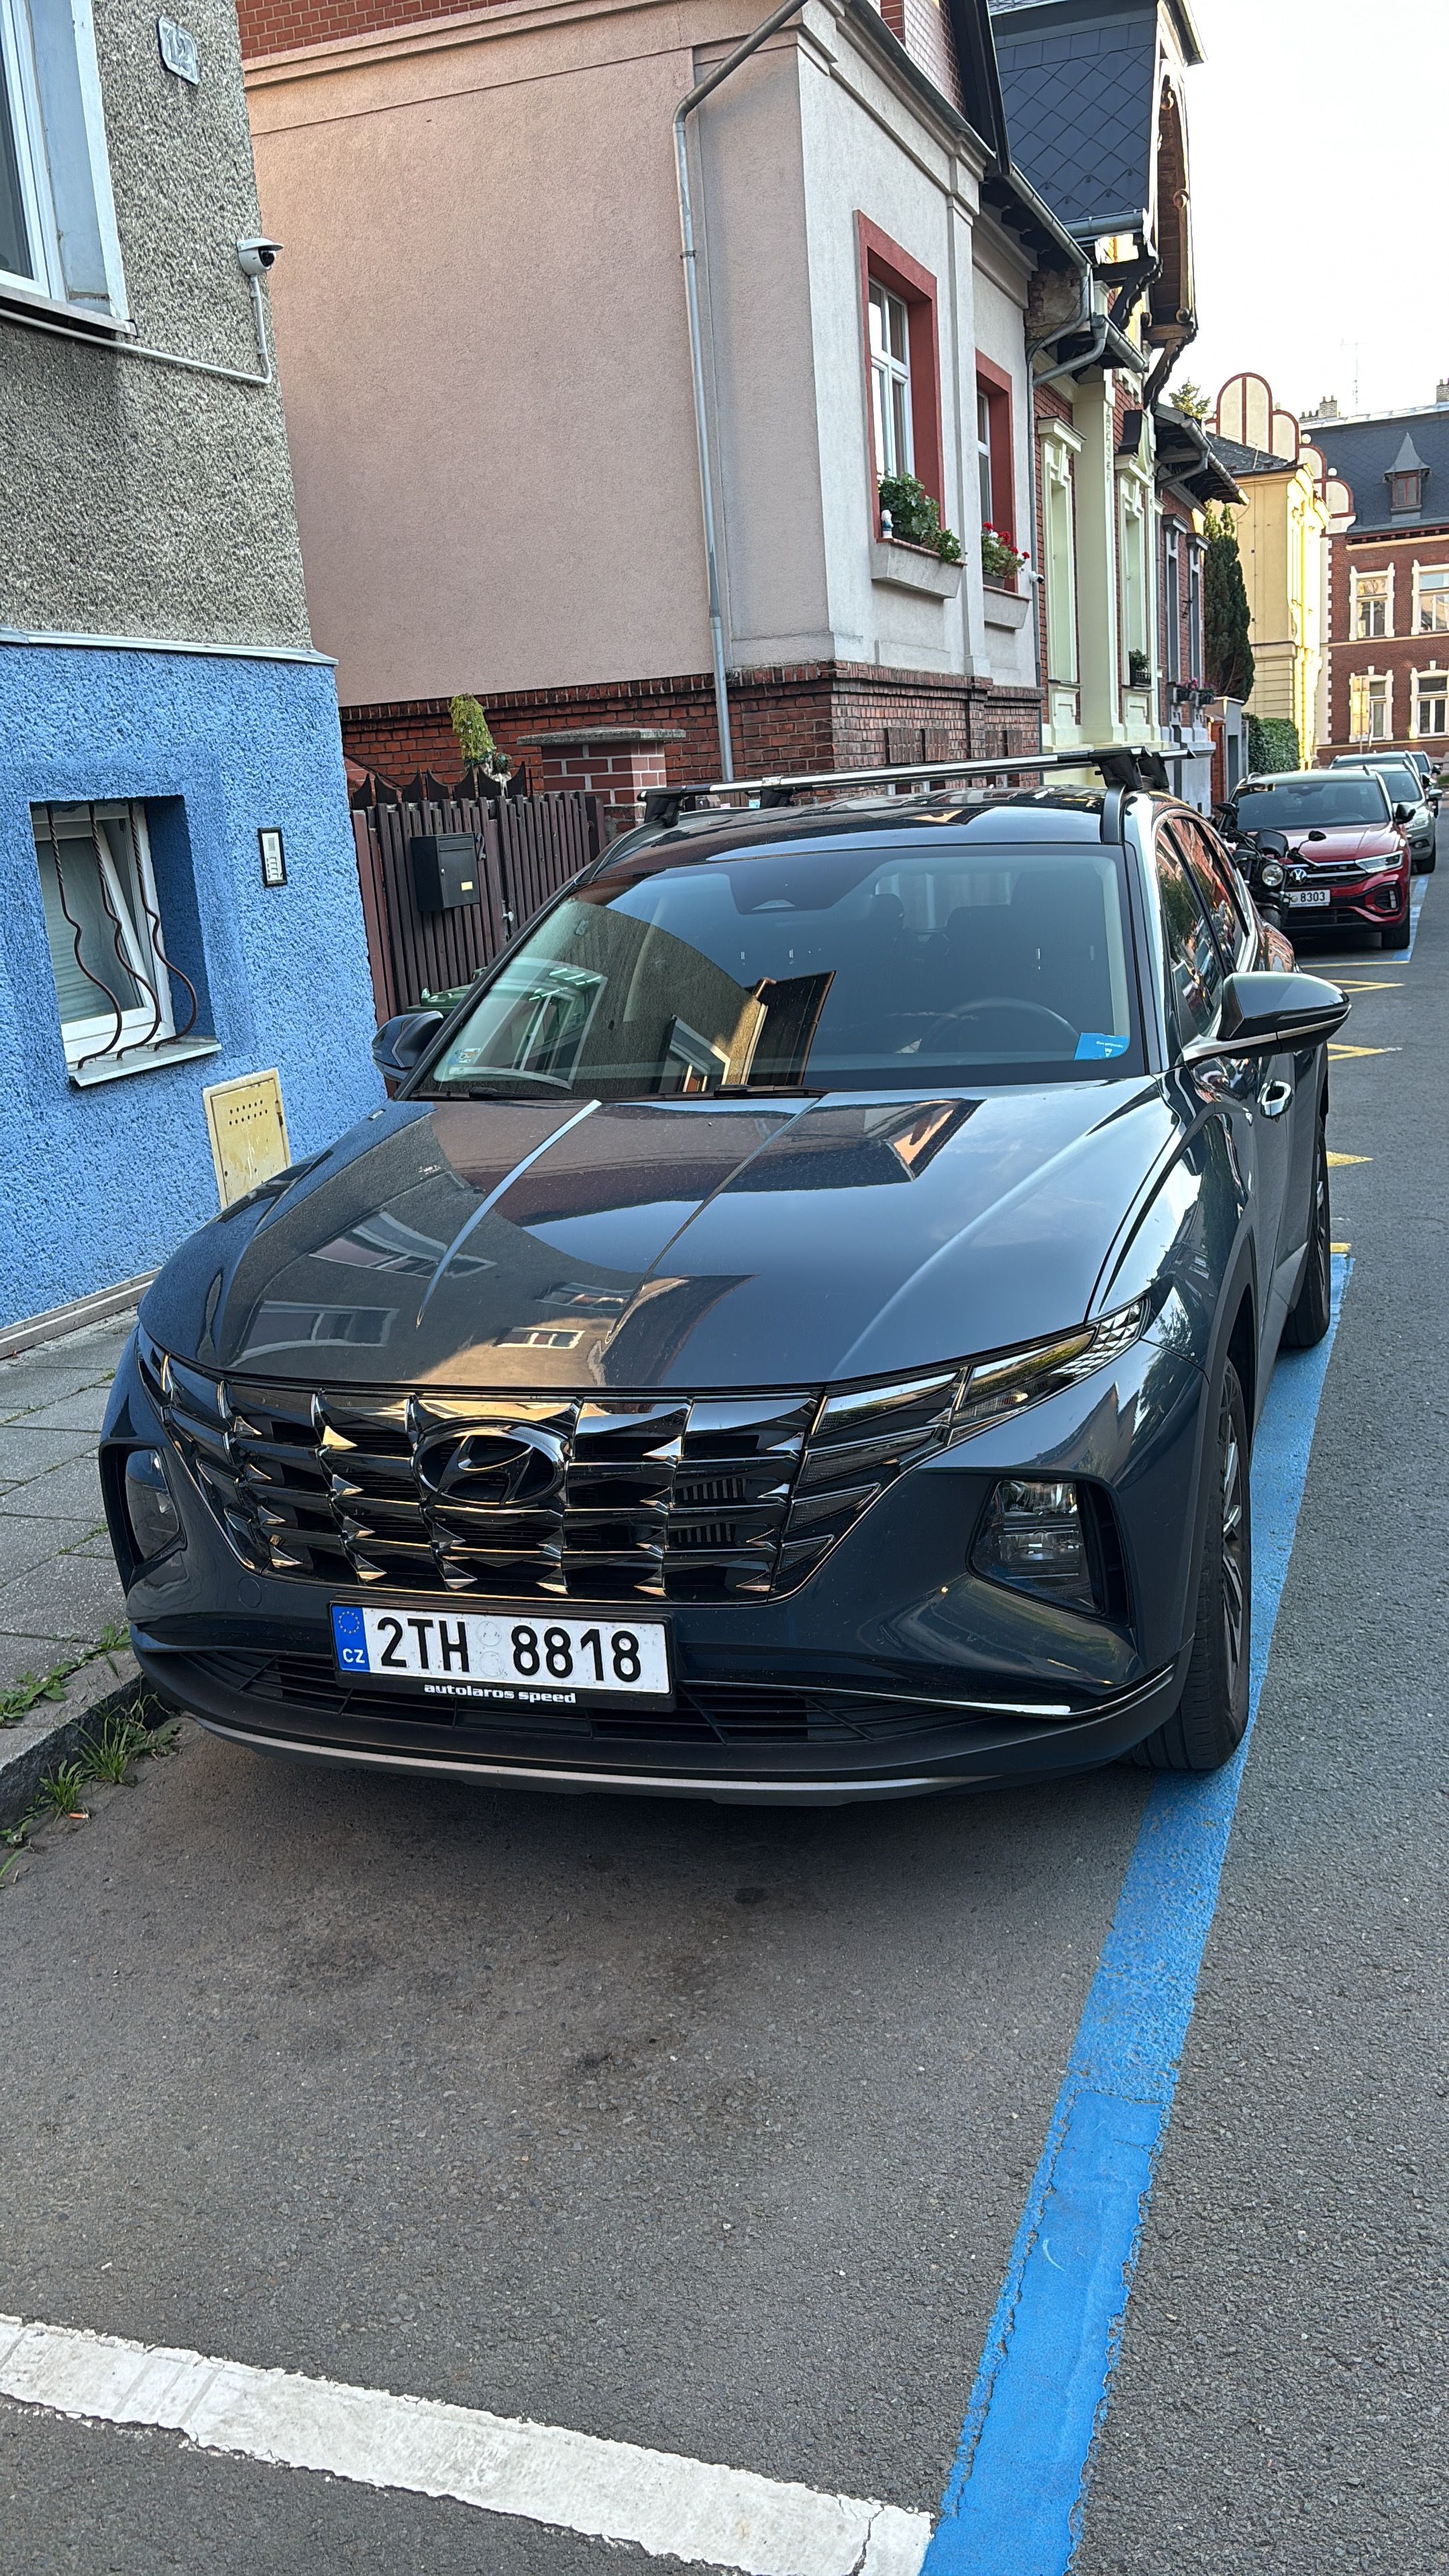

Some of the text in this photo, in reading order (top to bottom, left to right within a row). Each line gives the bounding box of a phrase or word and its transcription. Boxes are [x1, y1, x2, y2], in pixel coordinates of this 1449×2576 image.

[1300, 892, 1326, 902] 8303
[343, 1648, 366, 1664] CZ
[377, 1617, 641, 1682] 2TH 8818
[424, 1684, 576, 1703] autolaros speed
